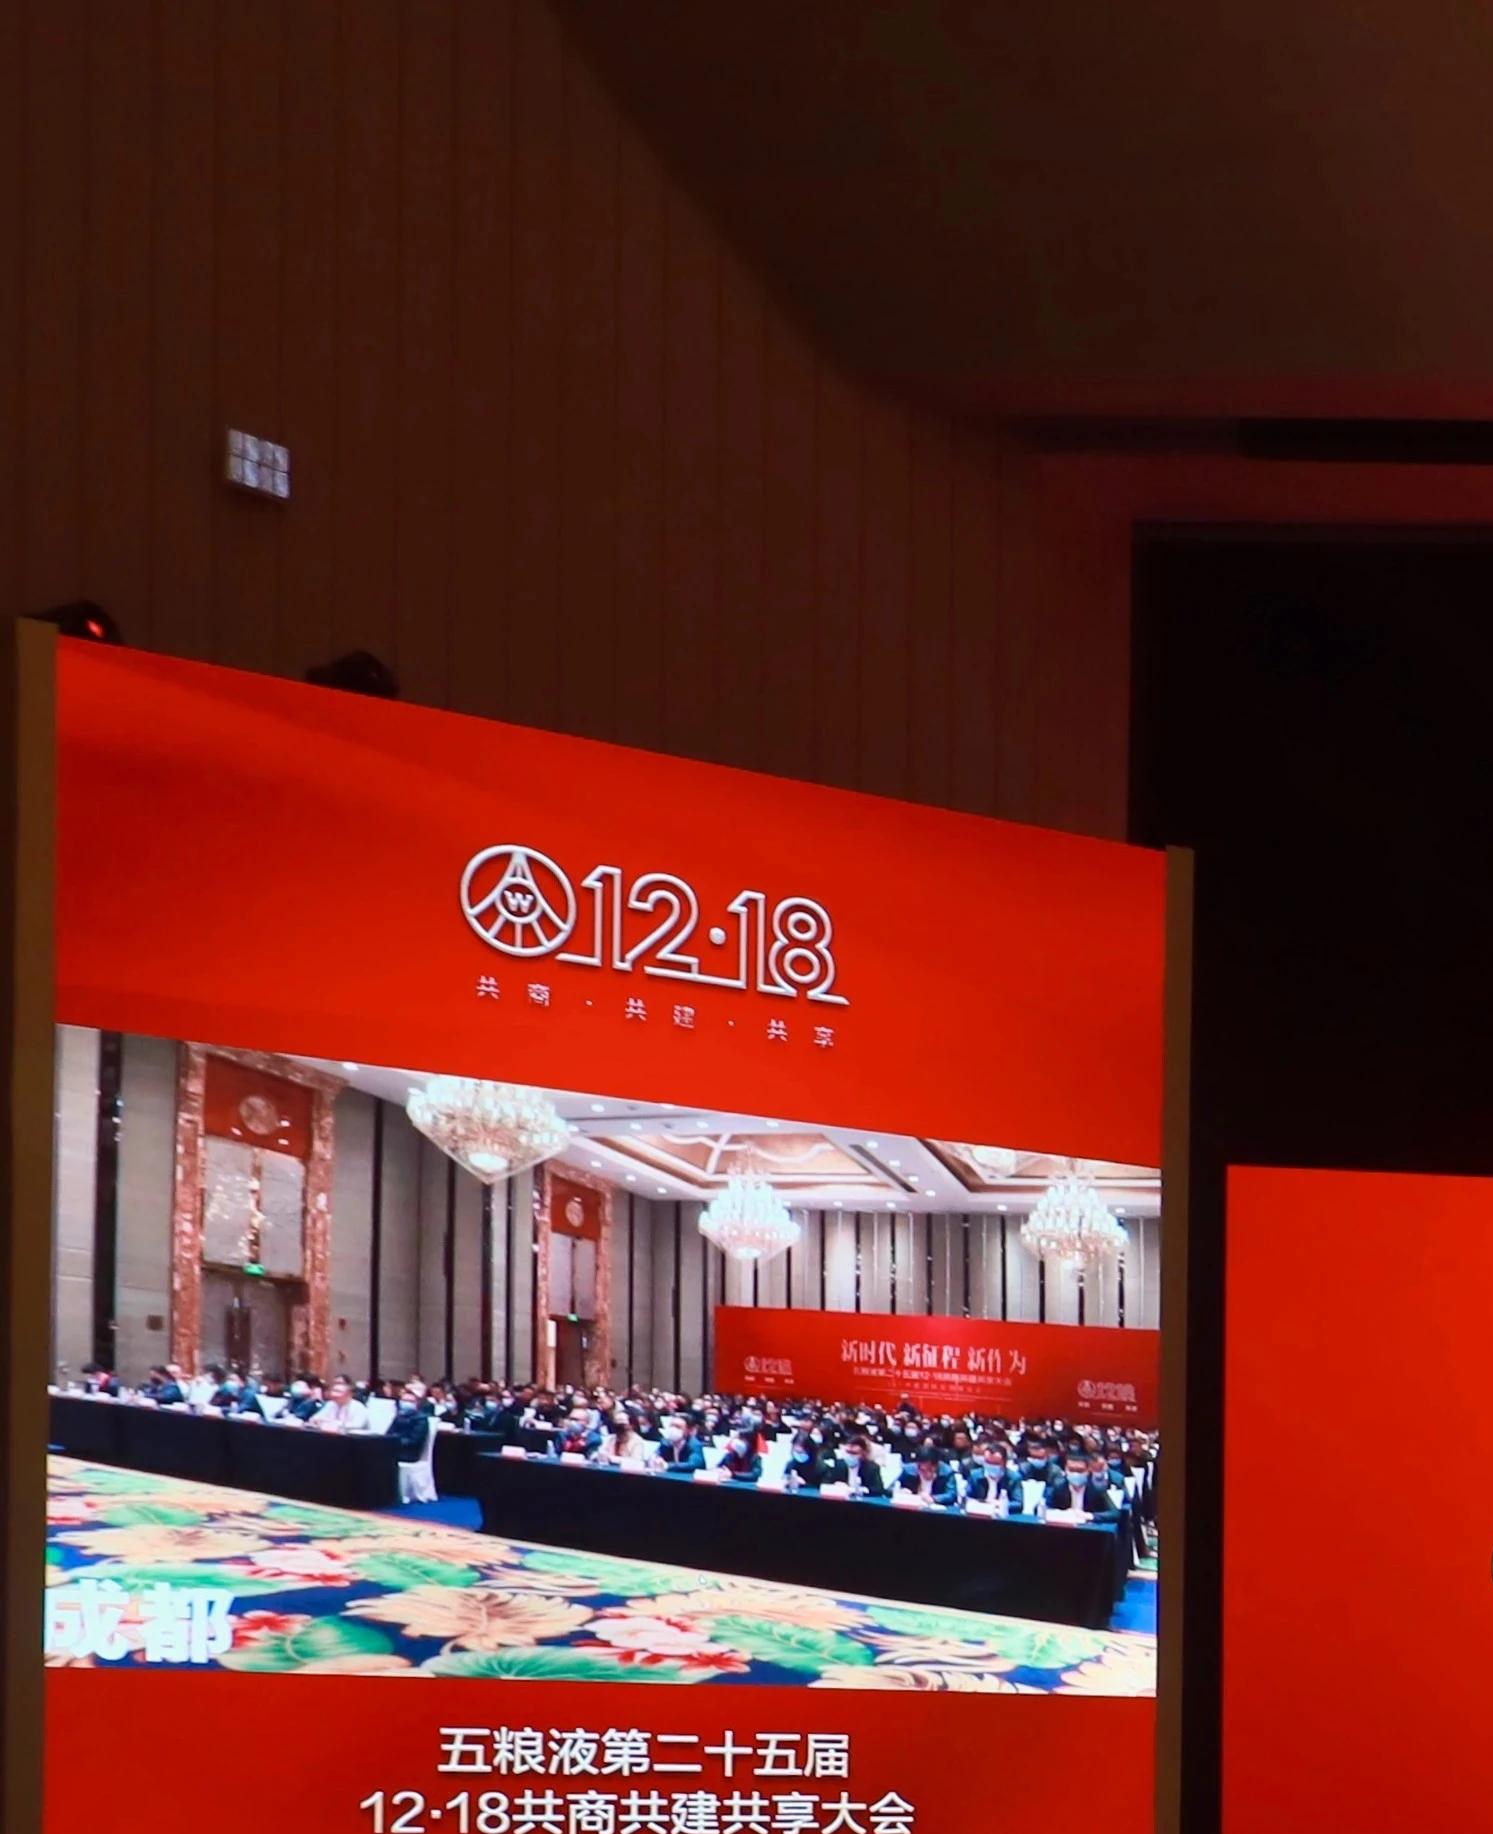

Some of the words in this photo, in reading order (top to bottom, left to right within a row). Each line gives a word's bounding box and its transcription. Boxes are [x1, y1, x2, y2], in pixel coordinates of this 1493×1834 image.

[438, 1727, 850, 1780] 五粮液第二十五届
